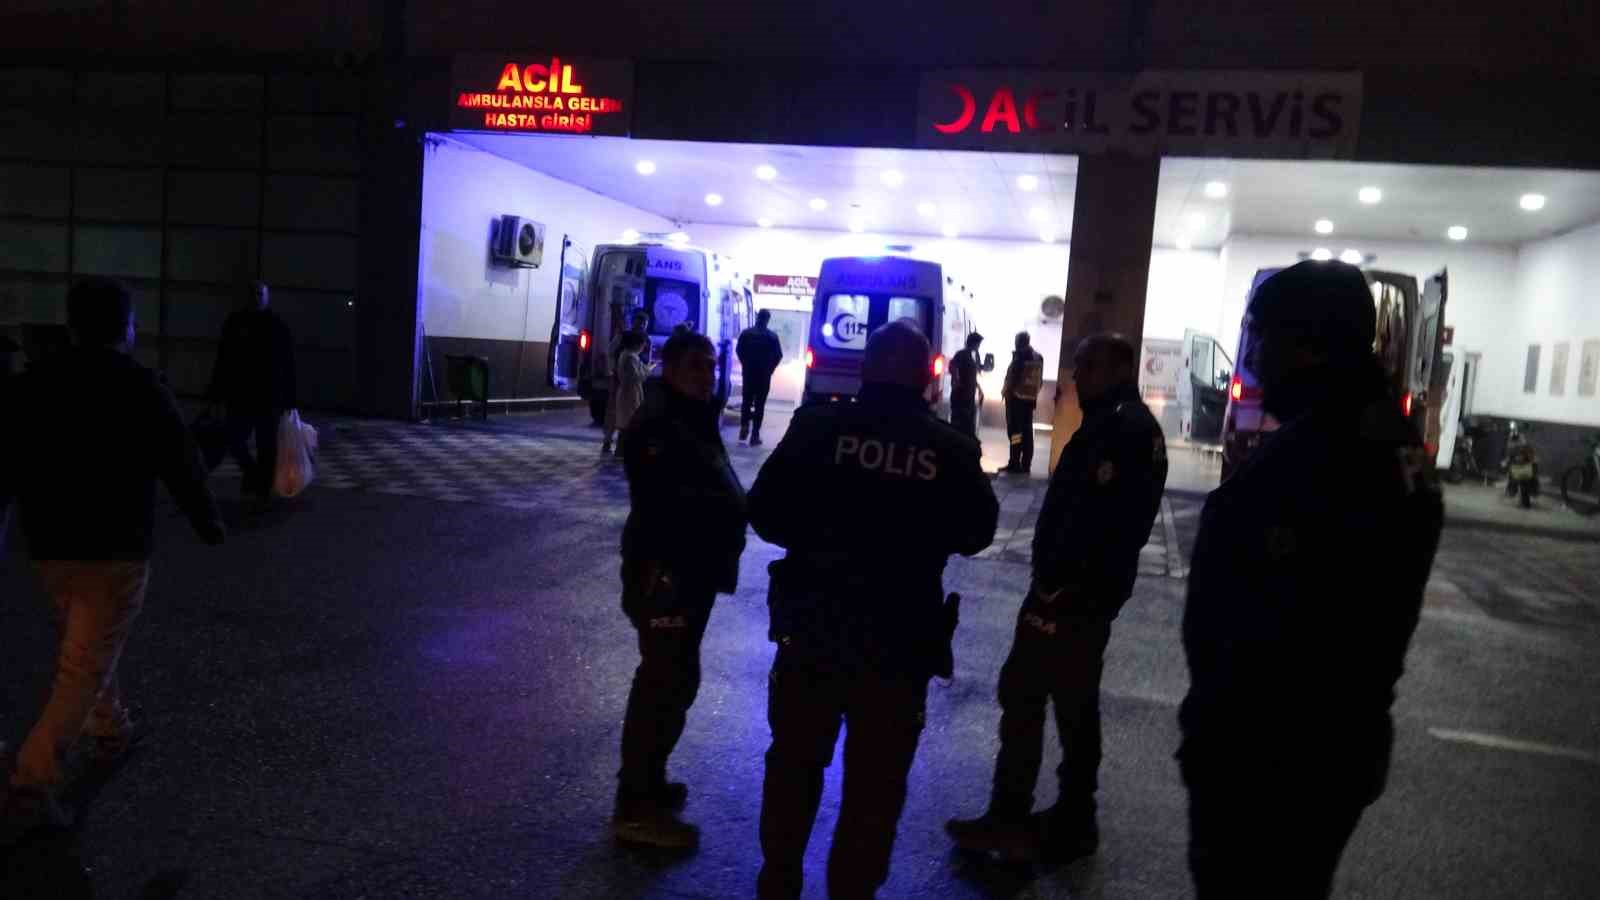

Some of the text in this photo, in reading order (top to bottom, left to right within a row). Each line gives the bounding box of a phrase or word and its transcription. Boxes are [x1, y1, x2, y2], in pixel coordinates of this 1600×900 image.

[498, 56, 582, 93] ACİL
[458, 93, 564, 110] AMBULANSLA
[485, 113, 537, 128] HASTA
[845, 321, 866, 335] 112
[835, 435, 938, 481] POLİS
